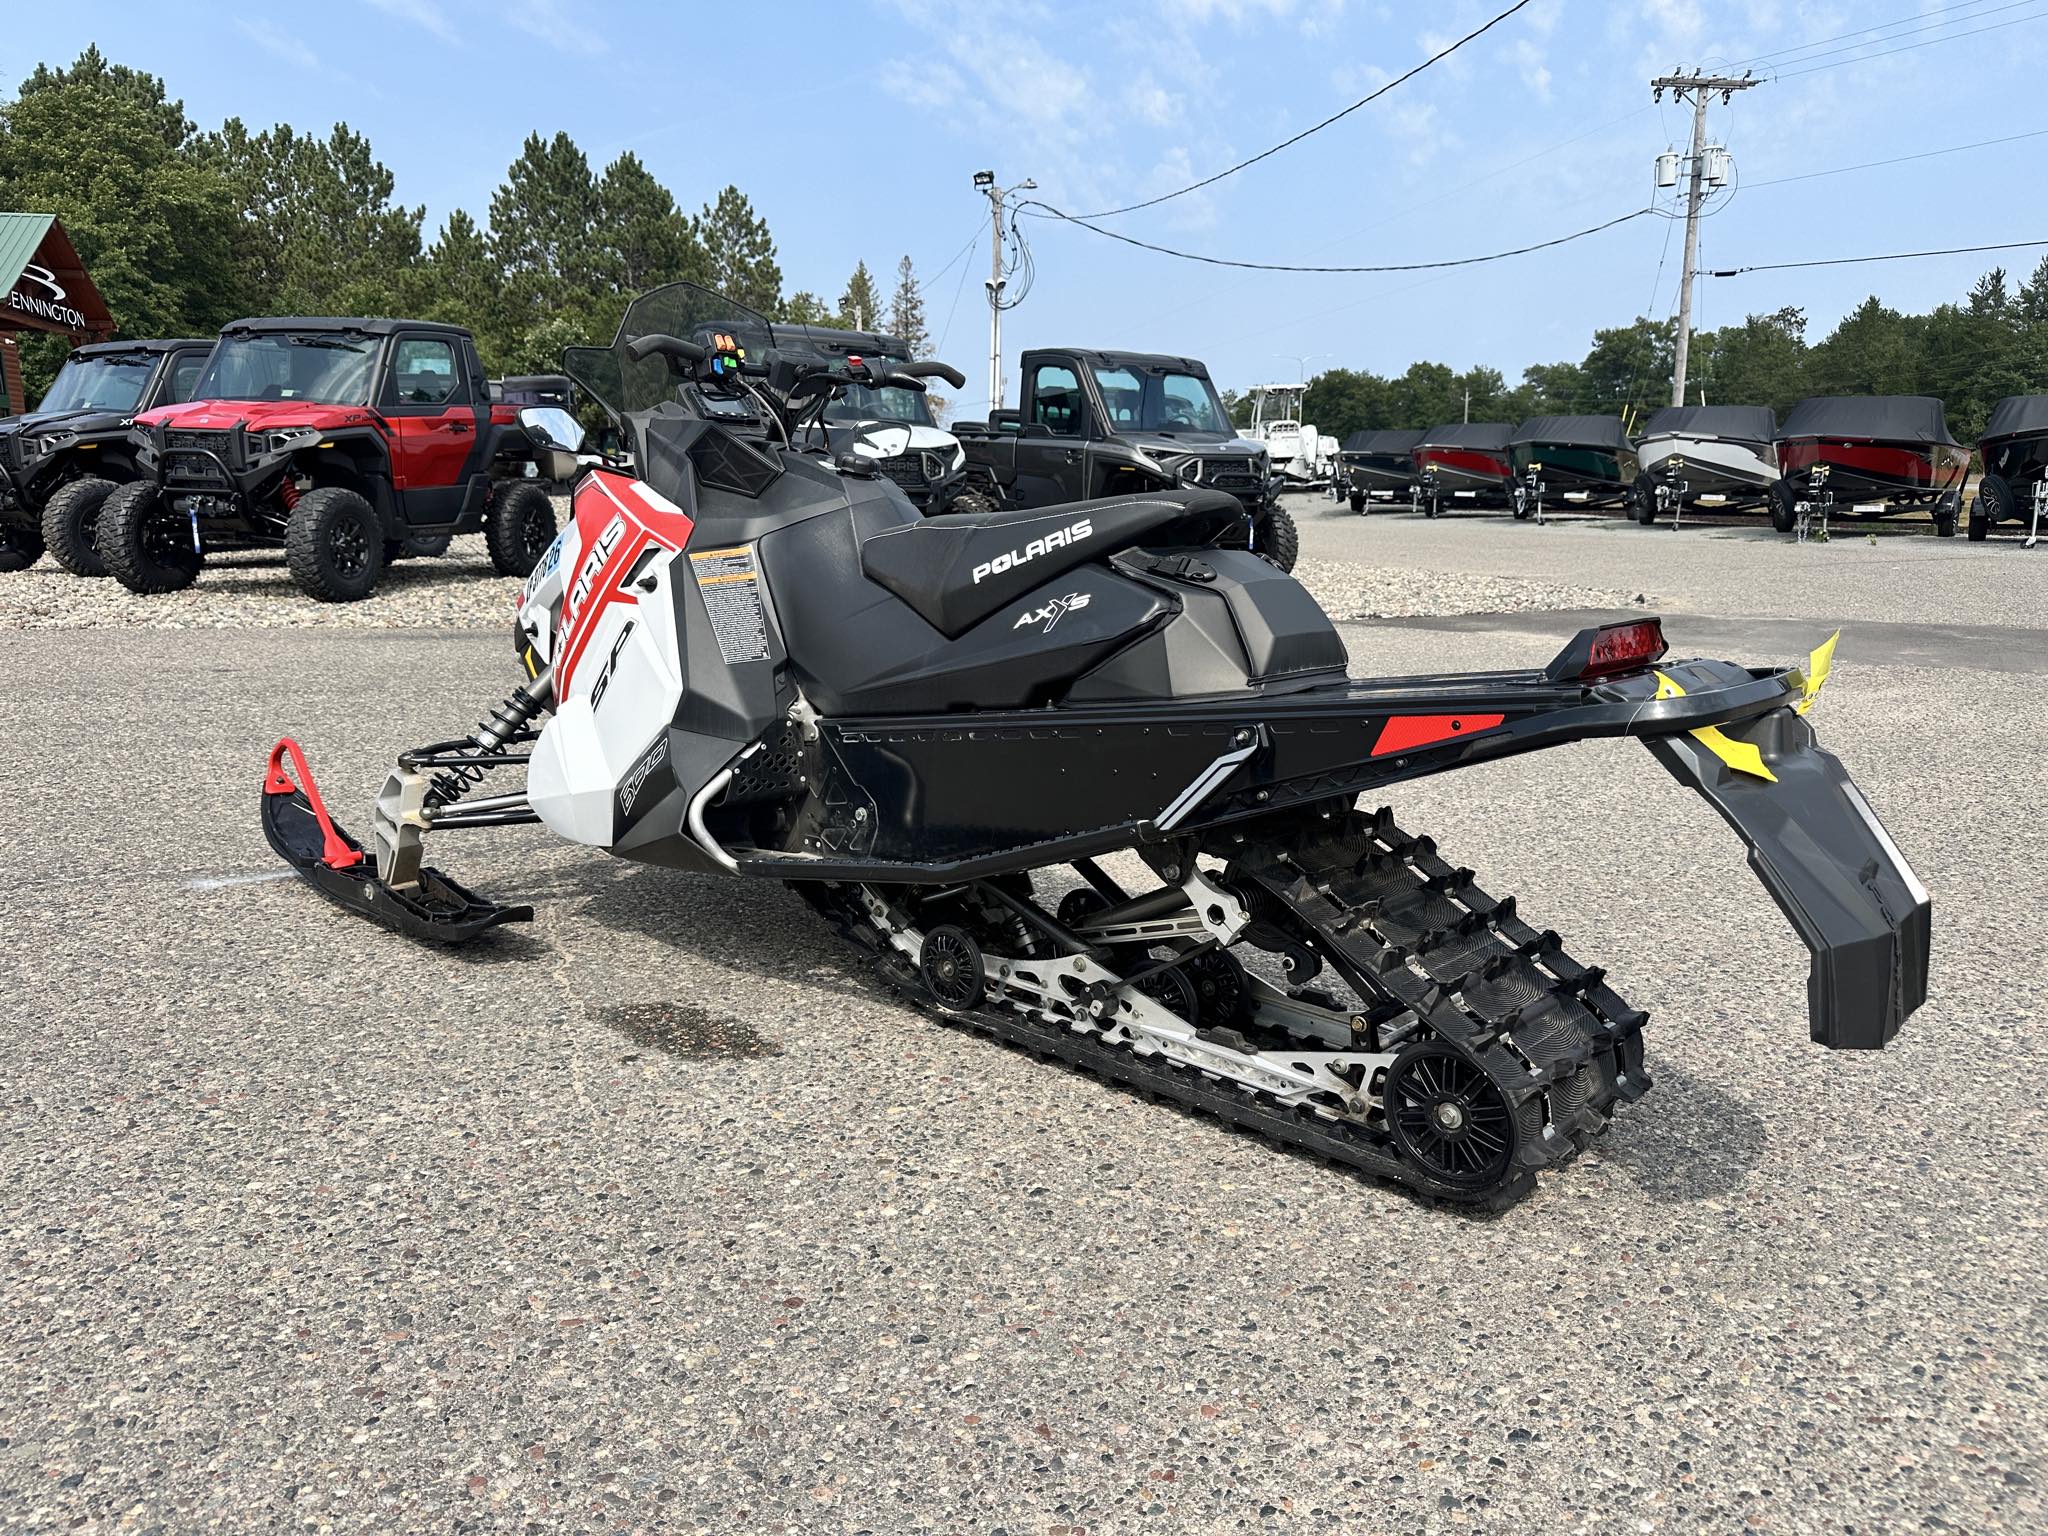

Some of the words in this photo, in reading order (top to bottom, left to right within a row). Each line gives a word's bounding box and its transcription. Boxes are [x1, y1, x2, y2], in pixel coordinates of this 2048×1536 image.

[8, 291, 86, 328] ENNINGTON
[547, 540, 562, 571] 26
[972, 519, 1093, 585] POLARIS
[590, 616, 637, 715] SP
[619, 737, 668, 817] 600
